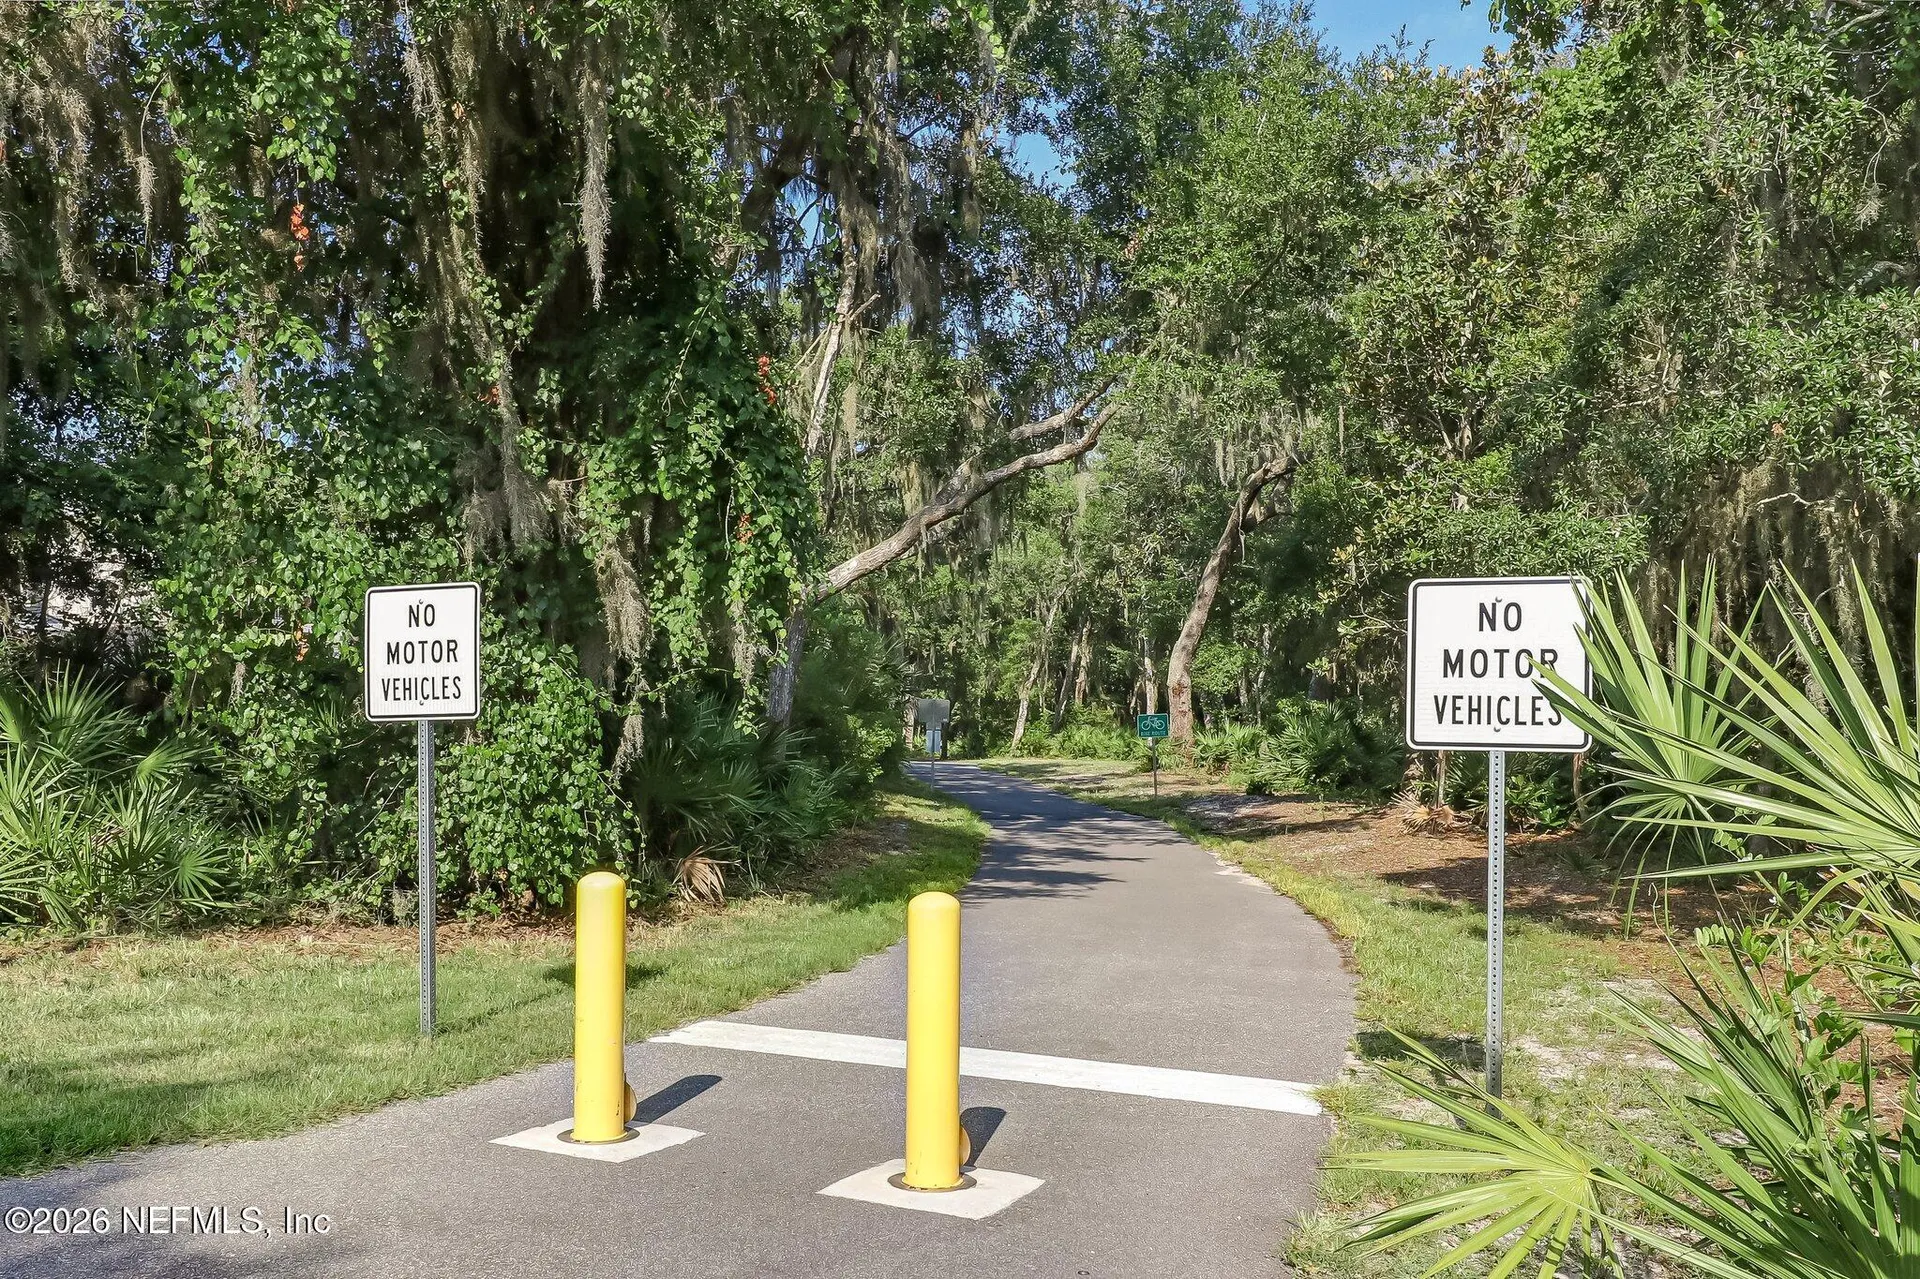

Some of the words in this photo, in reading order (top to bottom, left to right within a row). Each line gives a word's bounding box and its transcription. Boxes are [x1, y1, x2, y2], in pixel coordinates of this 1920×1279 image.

[408, 603, 436, 628] NO
[1478, 602, 1522, 632] NO
[386, 639, 458, 665] MOTOR
[1442, 648, 1559, 679] MOTOR
[381, 676, 461, 702] VEHICLES
